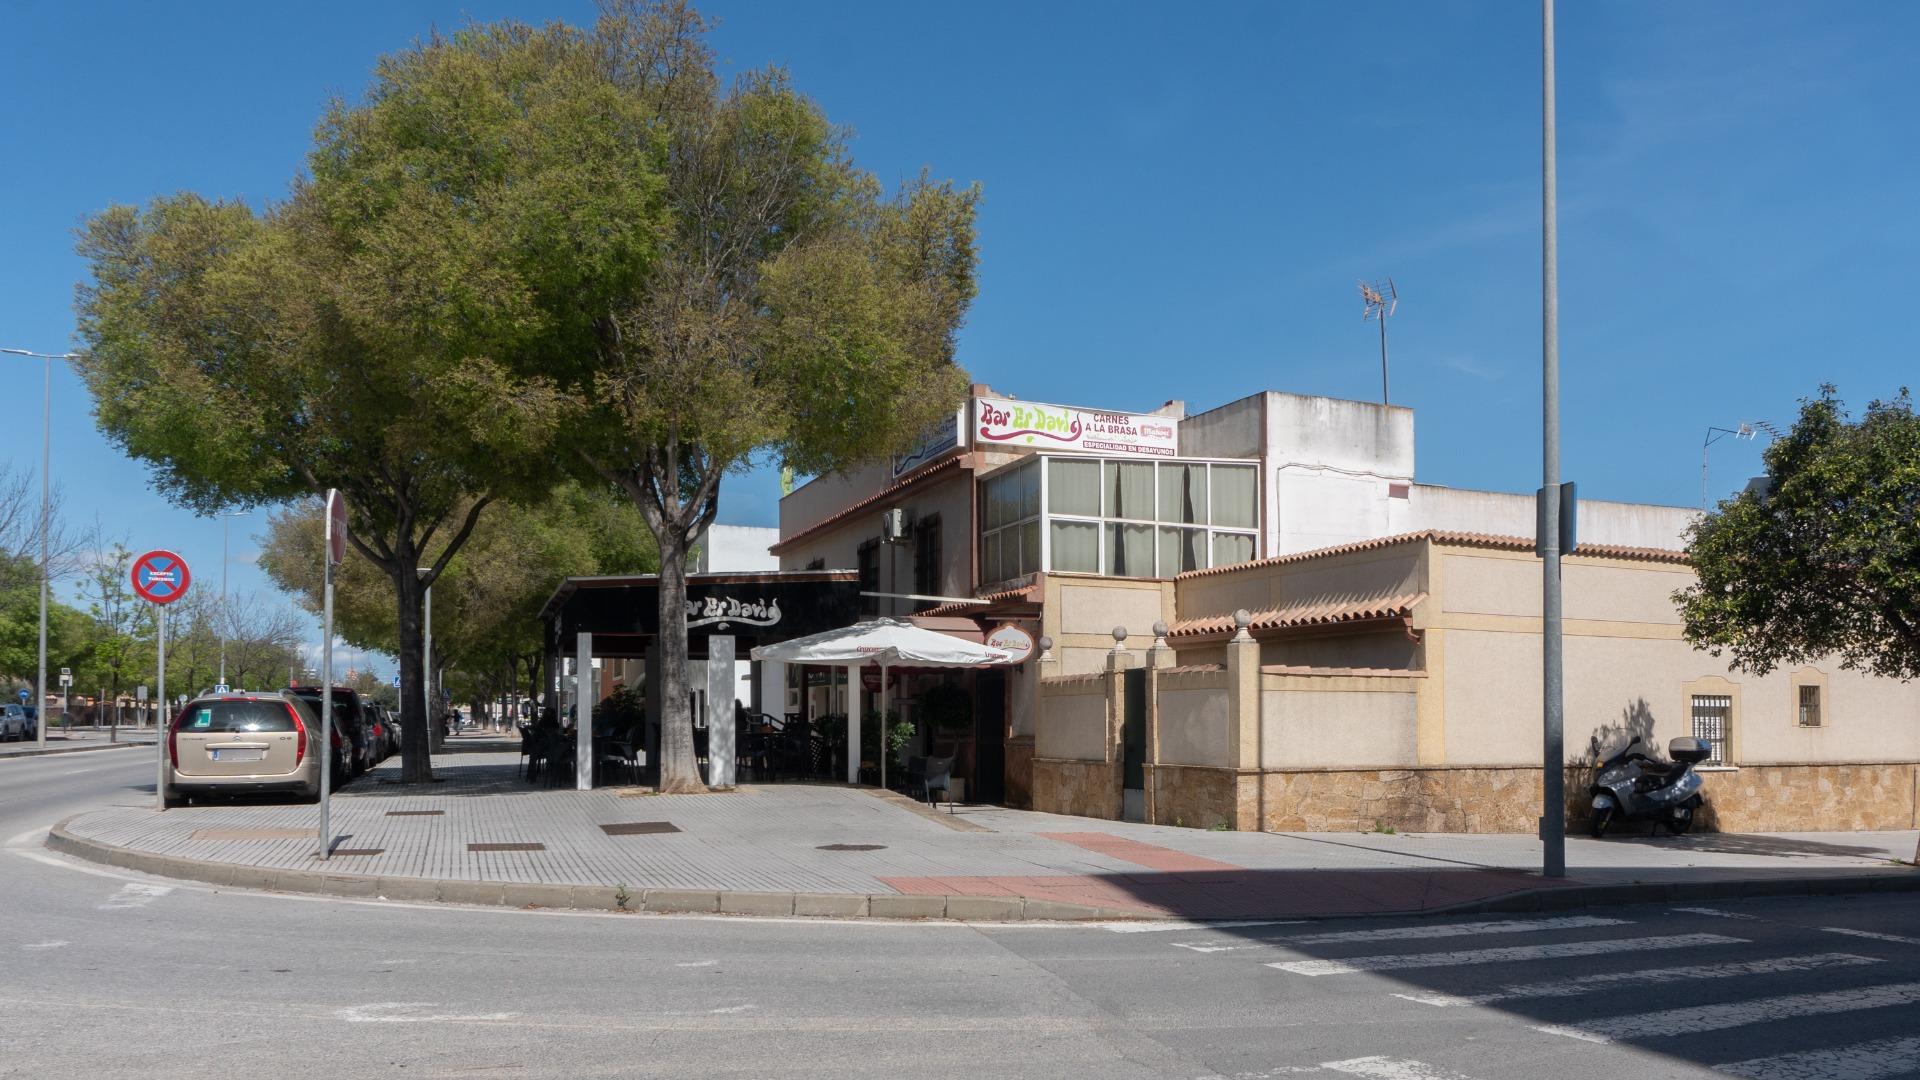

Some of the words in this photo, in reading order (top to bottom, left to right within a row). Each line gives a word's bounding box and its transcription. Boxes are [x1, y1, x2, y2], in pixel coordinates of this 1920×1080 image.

[980, 400, 1010, 426] Bar
[1012, 406, 1033, 429] Er
[1033, 406, 1082, 435] David
[1093, 413, 1129, 425] CARNES
[1085, 423, 1092, 431] A
[1094, 424, 1105, 433] LA
[1107, 425, 1138, 436] BRASA
[1084, 441, 1127, 452] ESPECIALIDAD
[1128, 445, 1137, 453] EN
[1137, 446, 1174, 456] DESAYUNOS
[686, 600, 702, 616] ar
[703, 596, 727, 617] Er
[726, 596, 782, 620] David
